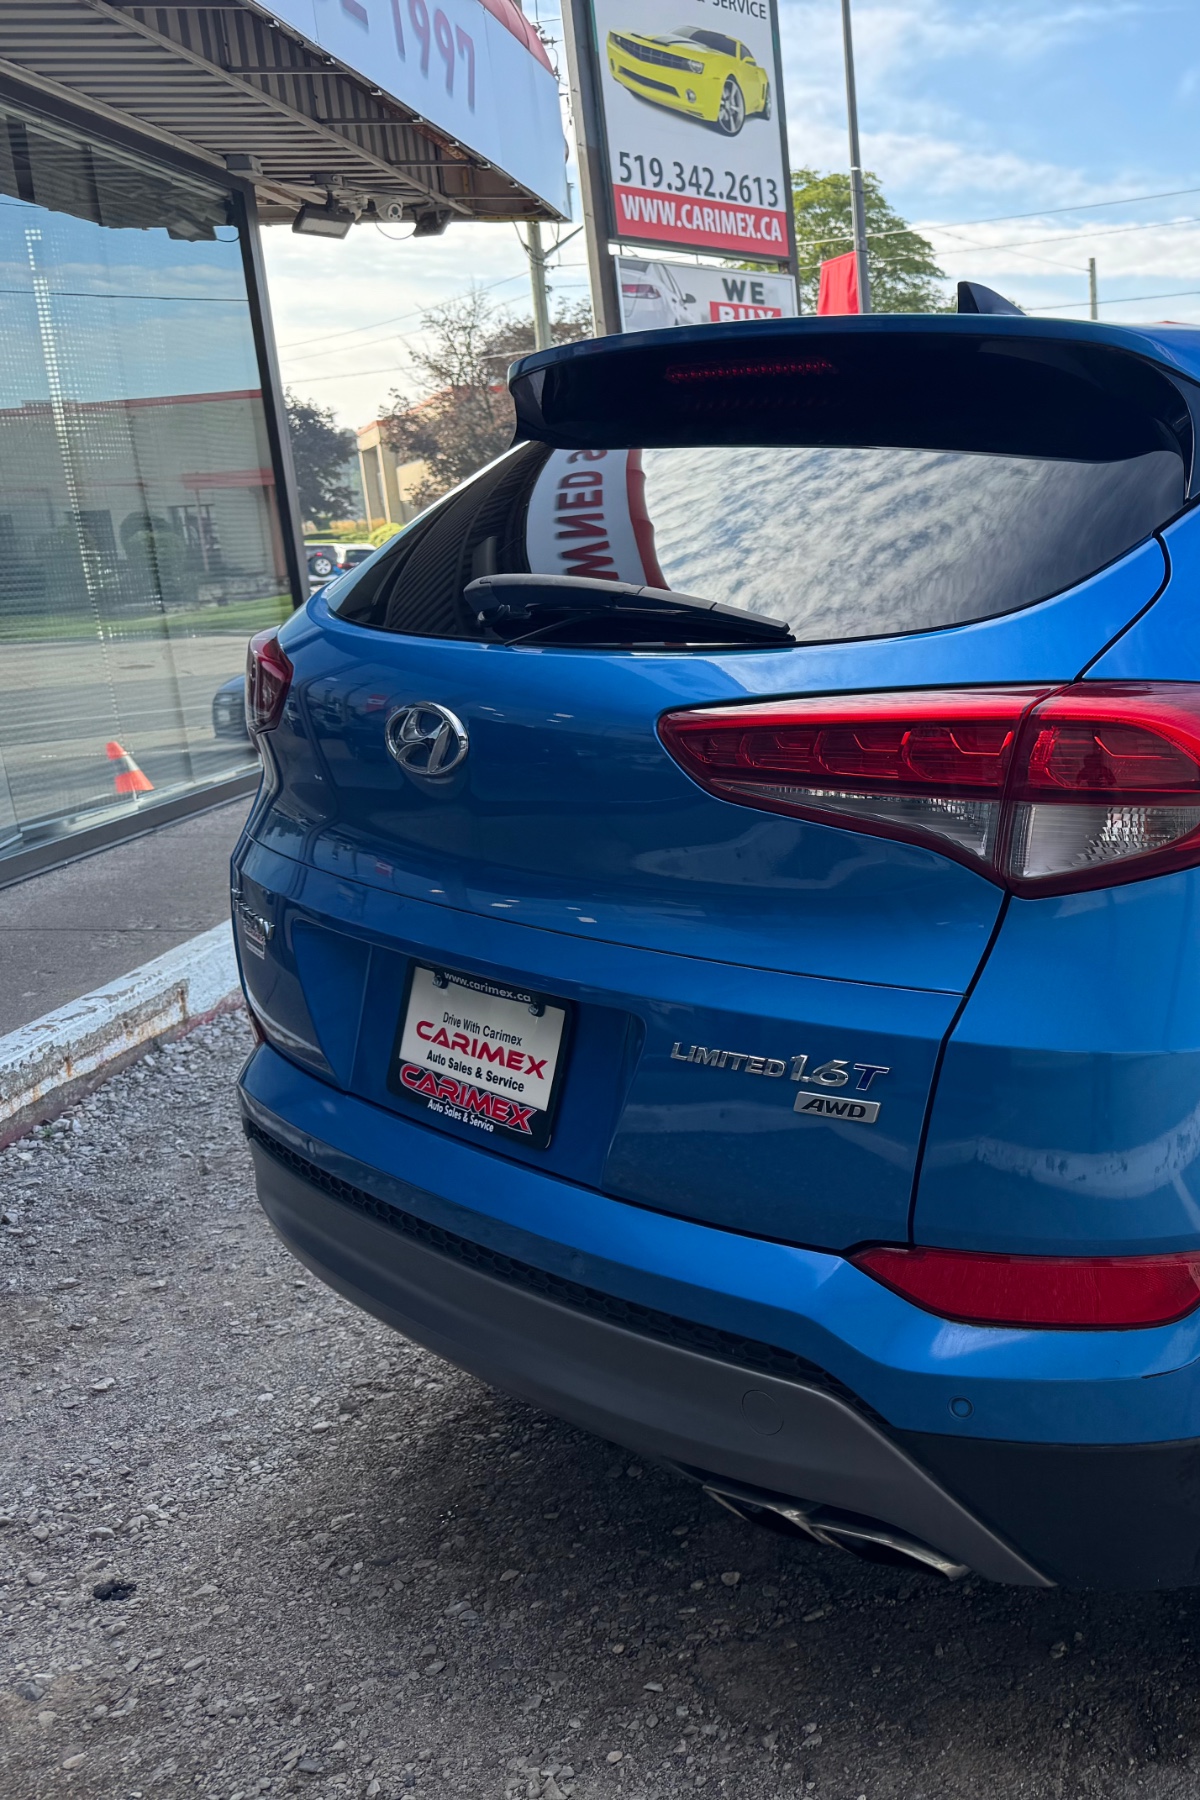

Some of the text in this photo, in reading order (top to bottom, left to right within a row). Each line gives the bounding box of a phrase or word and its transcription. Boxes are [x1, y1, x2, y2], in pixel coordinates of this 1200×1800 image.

[391, 0, 476, 114] 1997
[618, 151, 779, 208] 519.342.2613
[619, 193, 783, 243] WWW.CARIMEX.CA
[722, 278, 765, 305] WE
[444, 972, 531, 1003] www.carimex.ca
[443, 1011, 523, 1046] Drive With Carimex
[416, 1020, 549, 1080] CARIMEX
[670, 1041, 787, 1078] LIMITED
[426, 1050, 525, 1093] Auto Sales & Service
[401, 1063, 536, 1134] CARIMEX
[427, 1098, 495, 1133] Auto Sales & Service
[801, 1097, 867, 1119] AWD
